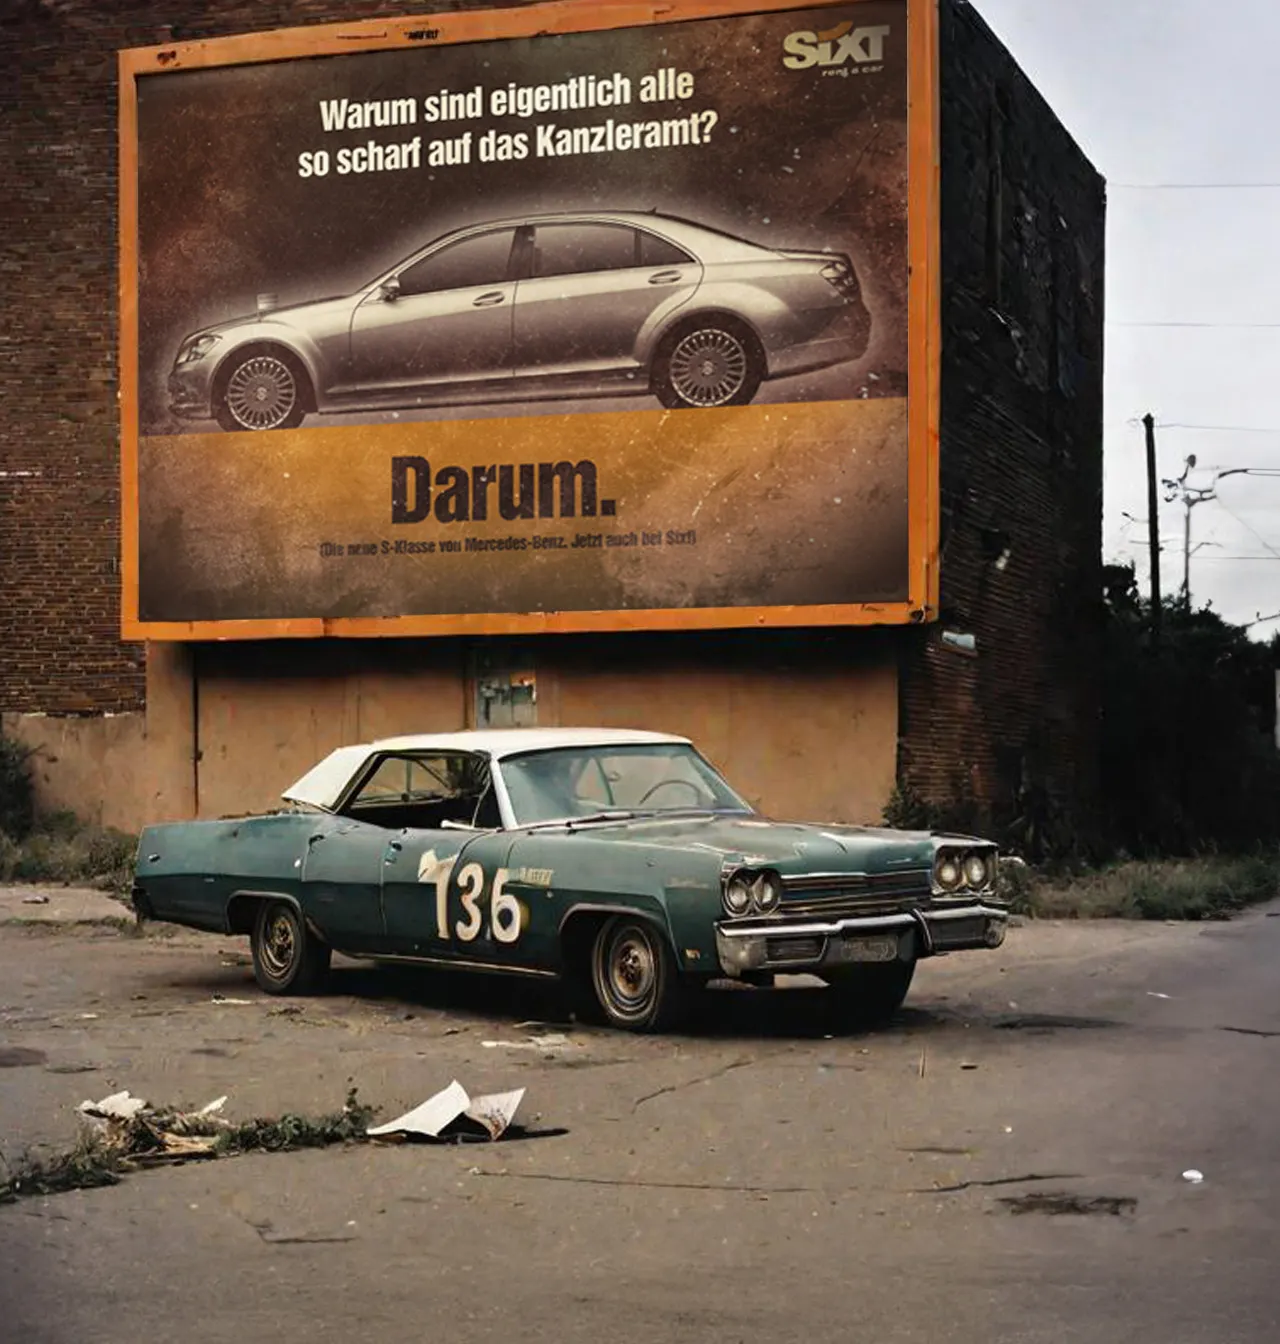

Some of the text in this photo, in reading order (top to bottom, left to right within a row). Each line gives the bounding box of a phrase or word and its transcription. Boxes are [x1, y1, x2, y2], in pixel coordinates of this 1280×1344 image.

[320, 67, 694, 131] Warum sind eigentlich alle
[822, 67, 848, 78] rent
[861, 65, 884, 73] car
[298, 110, 718, 178] so scharf auf das Kanzleramt?
[391, 455, 616, 524] Darum.
[381, 539, 436, 555] S-Klasse
[438, 539, 462, 553] von
[464, 535, 568, 551] Mercedes-Benz.
[571, 533, 603, 548] Jetzt
[606, 531, 638, 547] auch
[641, 531, 663, 546] bei
